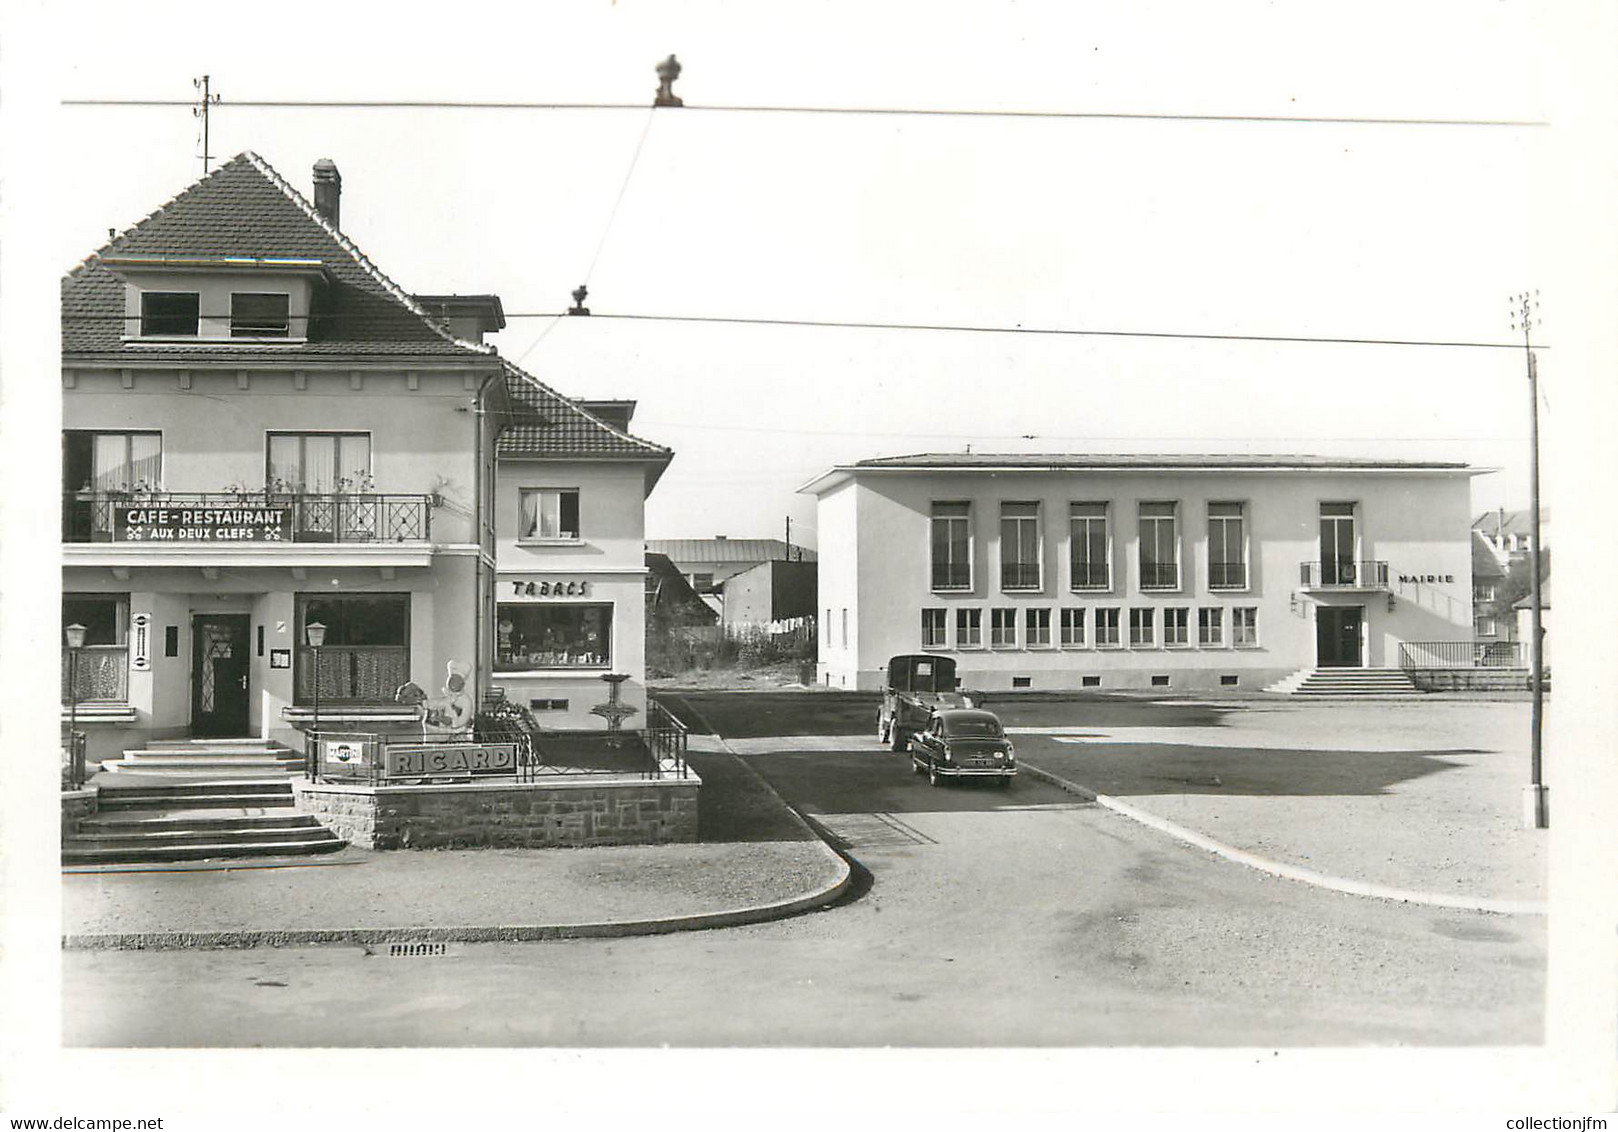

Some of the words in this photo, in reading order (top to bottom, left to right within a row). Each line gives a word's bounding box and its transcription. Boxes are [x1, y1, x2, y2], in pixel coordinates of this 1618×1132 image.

[178, 528, 210, 539] DEUX
[1398, 575, 1455, 584] MAIRIE
[512, 581, 587, 595] TABACS
[395, 751, 510, 772] RICARD
